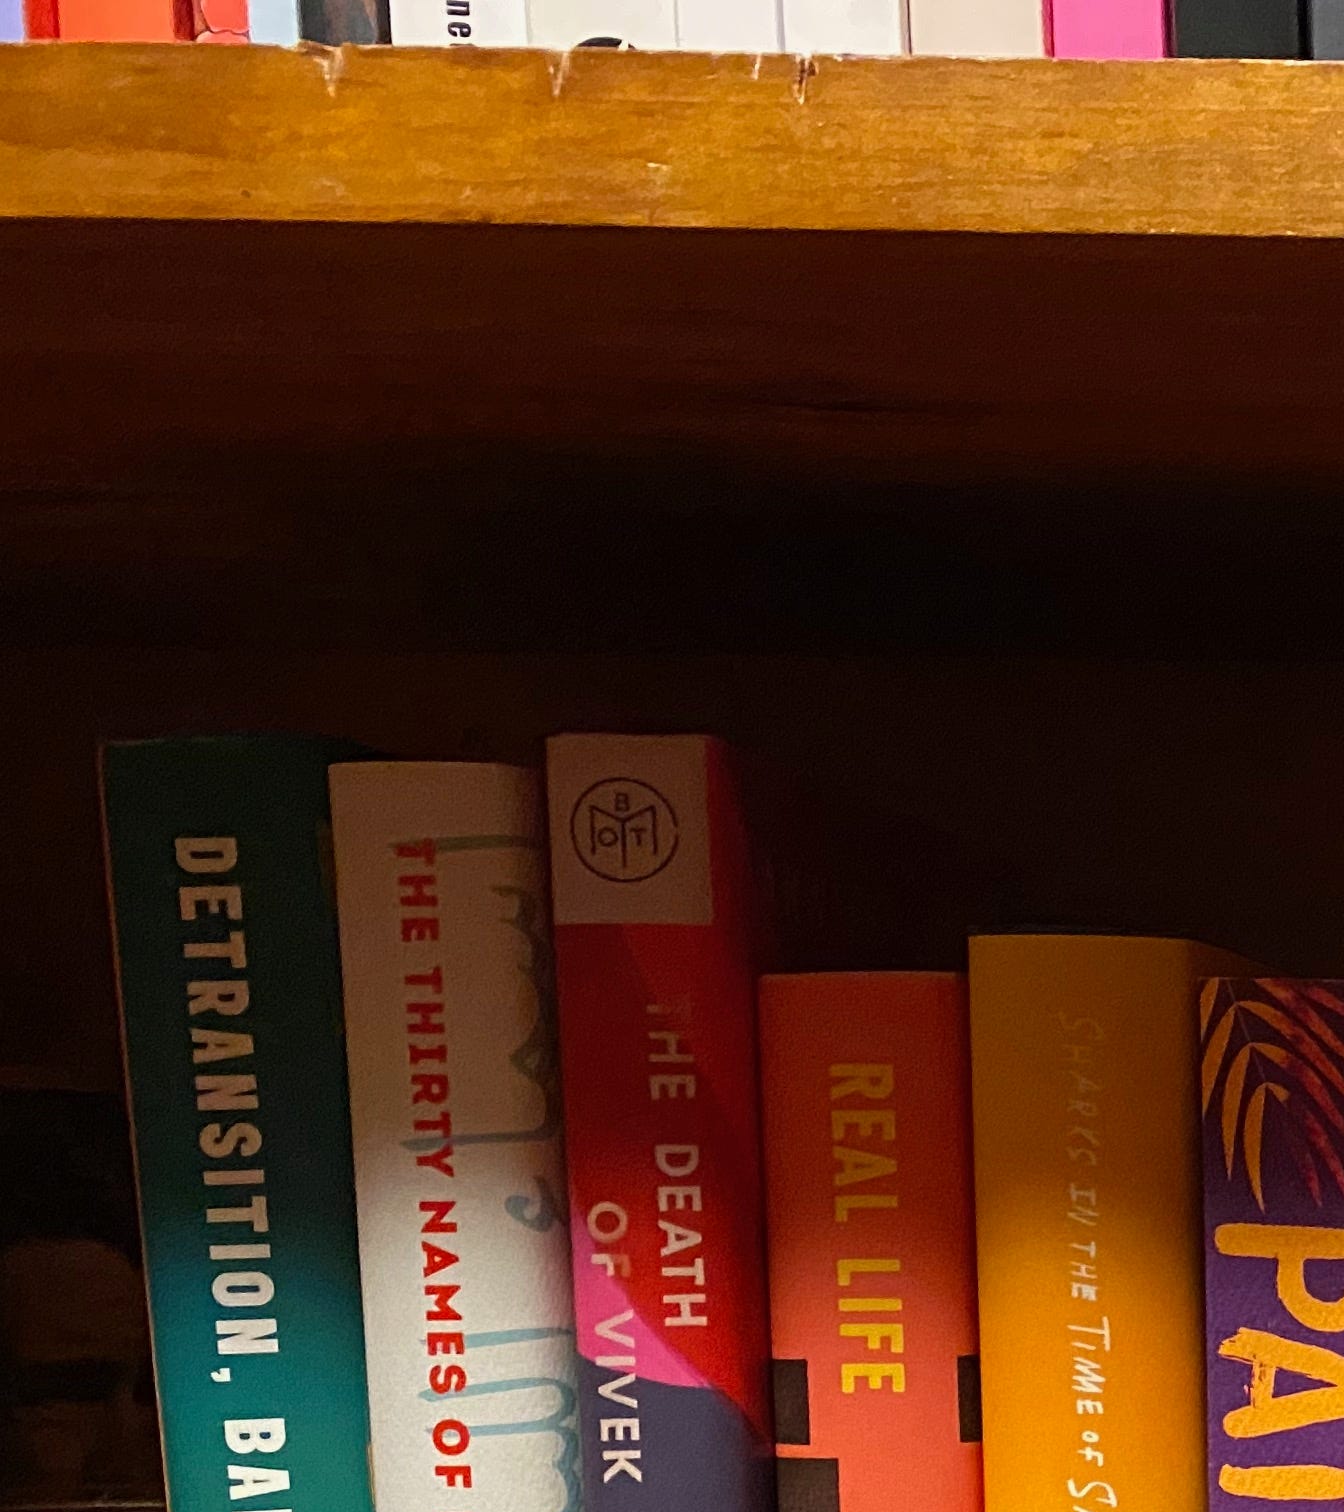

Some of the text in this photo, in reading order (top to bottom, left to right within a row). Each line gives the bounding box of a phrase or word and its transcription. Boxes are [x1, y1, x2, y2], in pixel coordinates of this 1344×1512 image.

[395, 841, 440, 943] THE
[175, 835, 279, 1384] DETRANSITION,
[403, 966, 455, 1178] THIRTY
[587, 1201, 632, 1279] OF
[645, 998, 708, 1327] THE DEATH
[828, 1062, 905, 1394] REAL LIFE
[419, 1201, 467, 1395] NAMES
[1069, 1240, 1098, 1302] THE
[594, 1308, 643, 1484] VIVEK
[1066, 1315, 1111, 1415] TIME
[432, 1418, 473, 1489] OF
